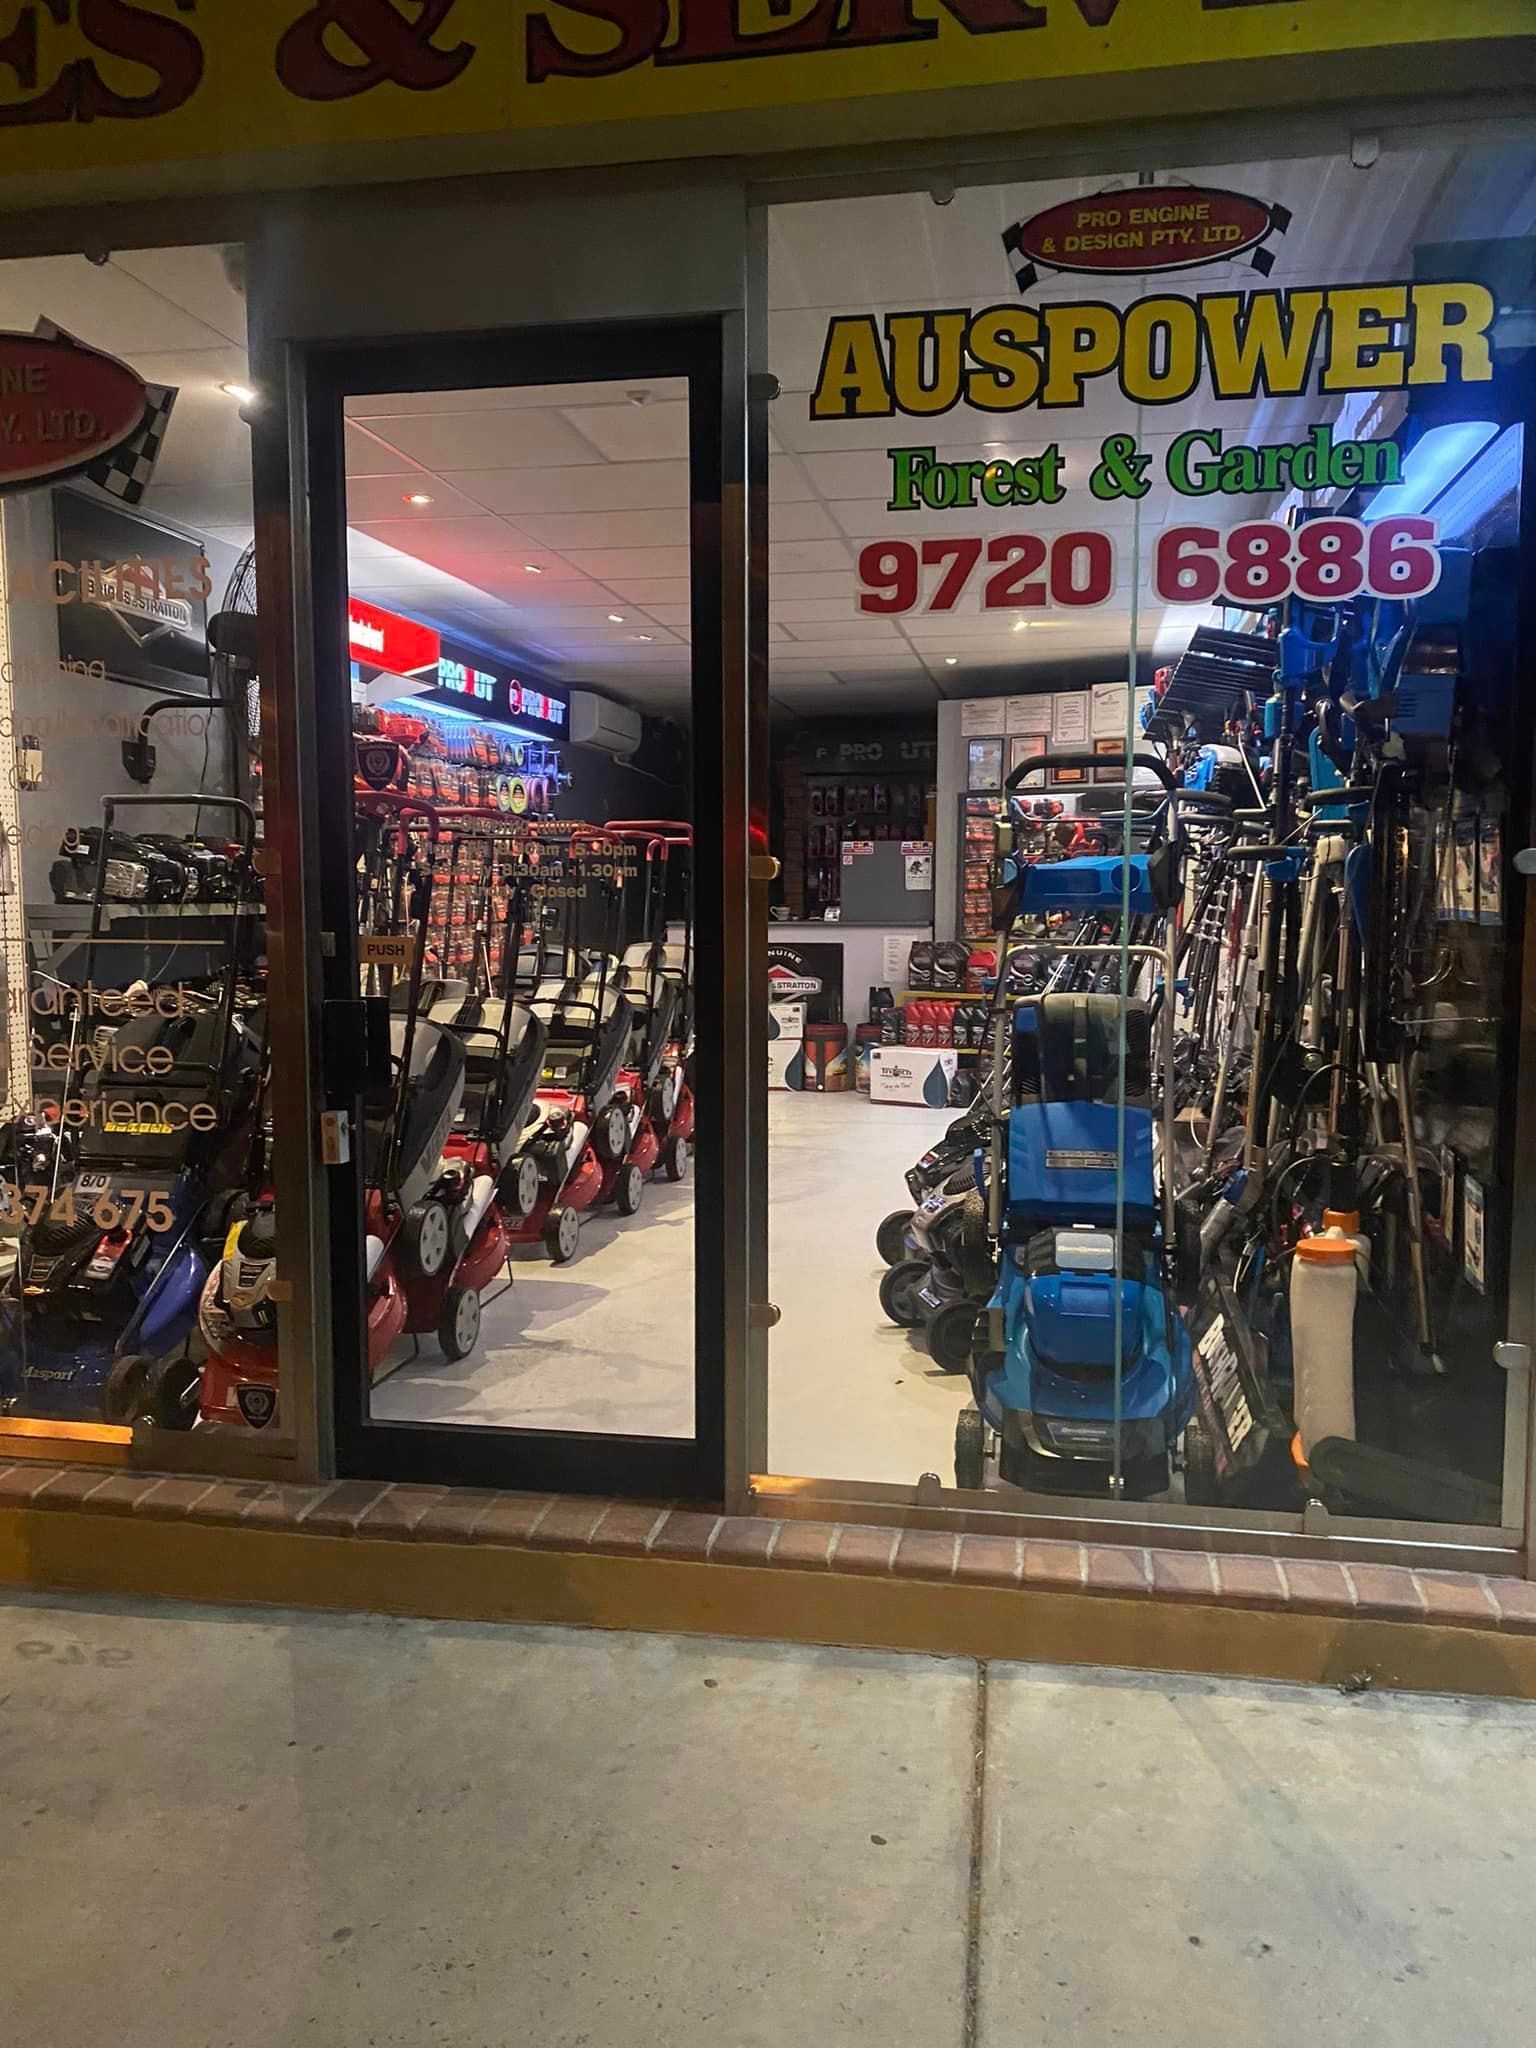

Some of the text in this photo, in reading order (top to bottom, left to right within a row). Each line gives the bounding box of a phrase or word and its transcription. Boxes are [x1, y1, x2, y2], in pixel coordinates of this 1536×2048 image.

[1076, 205, 1210, 229] PRO ENGINE
[1042, 224, 1246, 253] & DESIGN PTY. LTD.
[810, 282, 1496, 420] AUSPOWER
[887, 424, 1404, 511] Forest & Garden
[857, 514, 1442, 616] 9720 6886
[530, 883, 587, 898] Closed
[367, 944, 405, 956] PUSH
[31, 1031, 173, 1073] Service
[92, 1189, 174, 1232] 675
